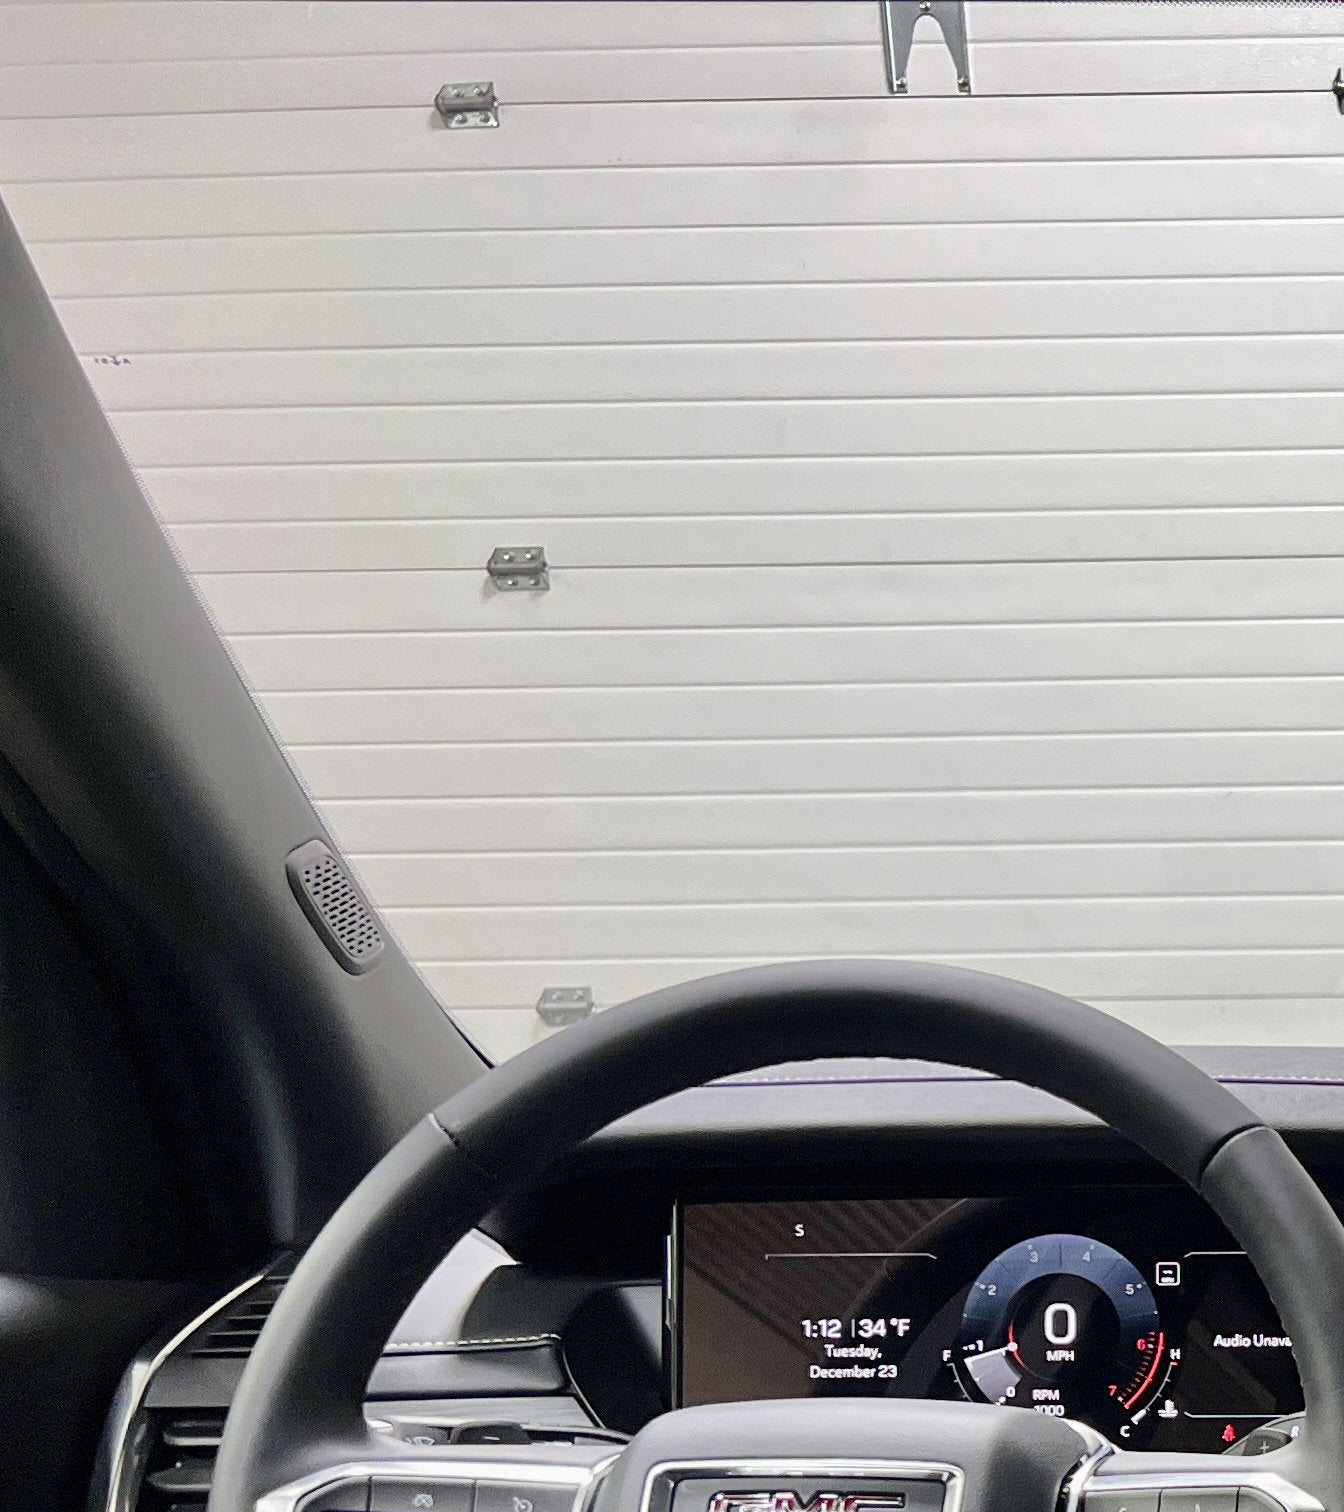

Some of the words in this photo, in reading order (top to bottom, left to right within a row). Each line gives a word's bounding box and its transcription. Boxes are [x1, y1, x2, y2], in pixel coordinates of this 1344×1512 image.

[987, 1284, 997, 1296] 2
[1125, 1283, 1135, 1295] 5
[802, 1318, 842, 1338] 1:12
[1044, 1302, 1077, 1345] 0
[1136, 1339, 1145, 1350] 6
[1213, 1334, 1251, 1347] Audio
[942, 1350, 951, 1361] F
[1046, 1350, 1075, 1362] MPH
[1169, 1348, 1181, 1360] H
[809, 1364, 876, 1379] December
[877, 1364, 898, 1378] 23
[1032, 1389, 1060, 1401] RPM
[1108, 1385, 1118, 1396] 7
[1120, 1425, 1130, 1437] C
